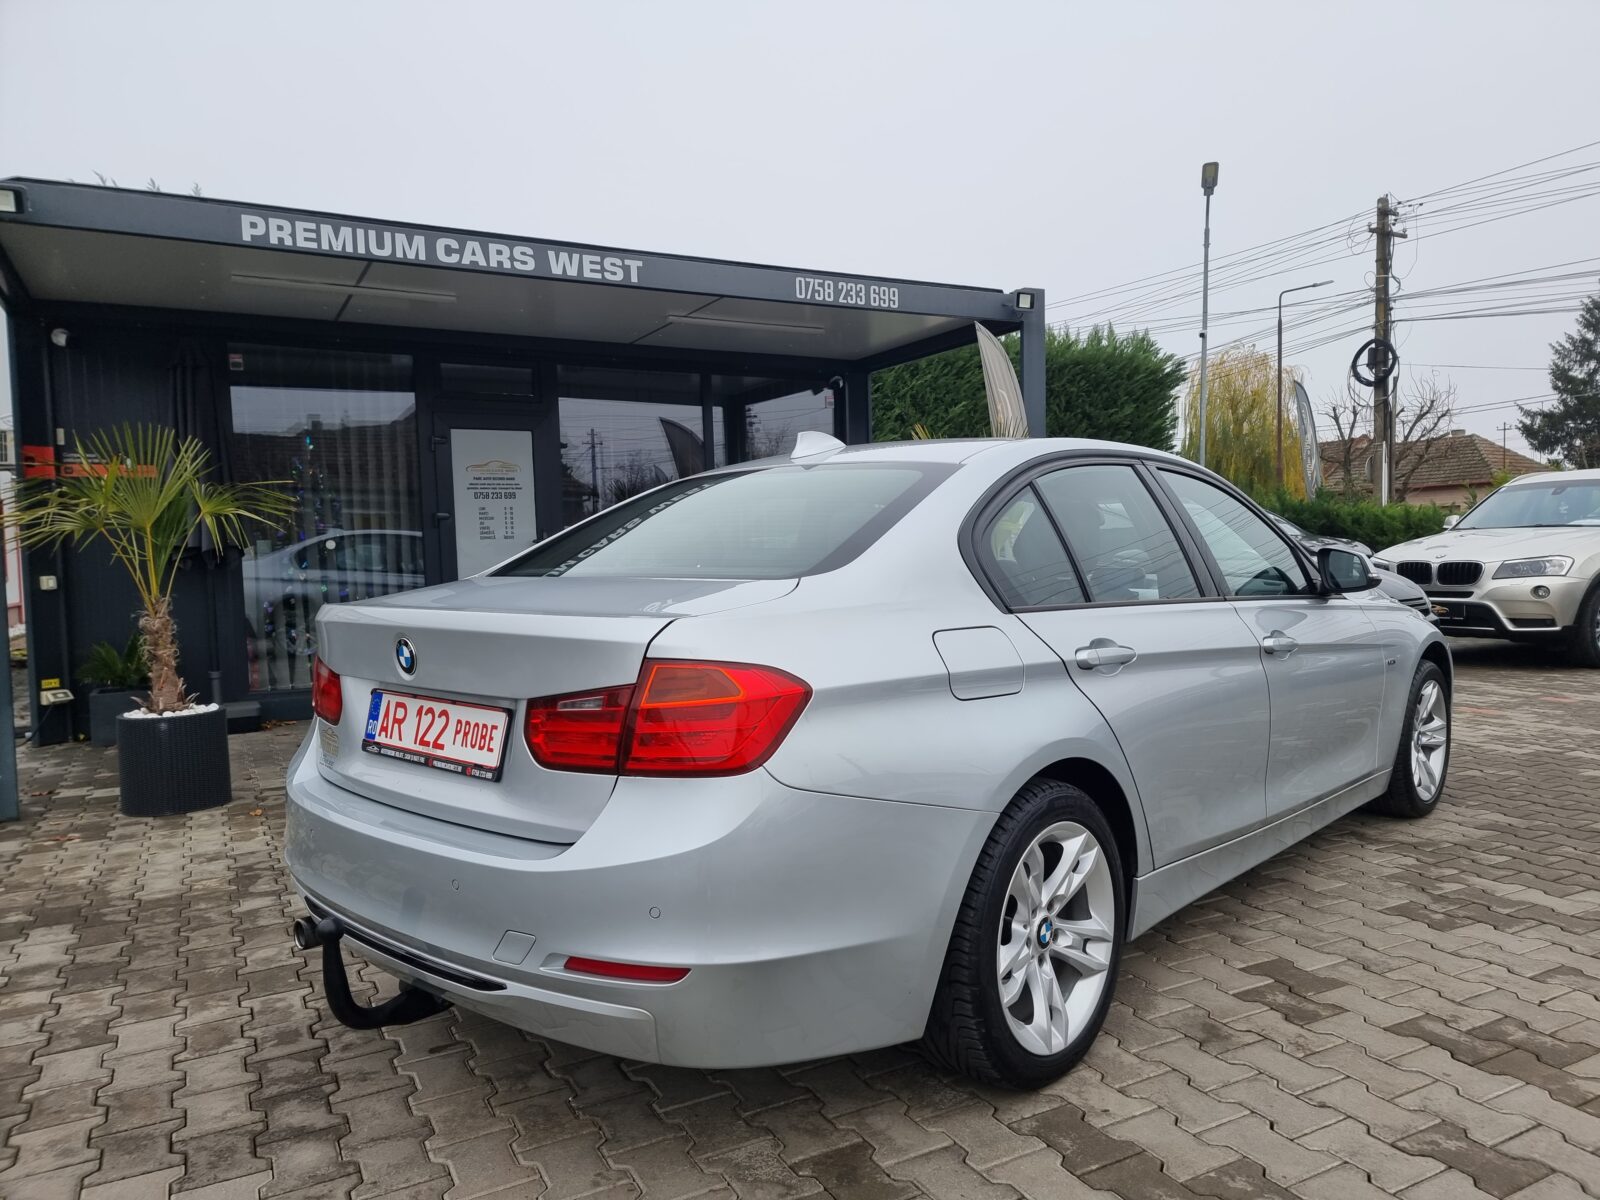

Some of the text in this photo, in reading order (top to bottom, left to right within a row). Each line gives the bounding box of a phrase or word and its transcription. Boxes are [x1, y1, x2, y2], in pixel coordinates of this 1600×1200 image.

[241, 214, 643, 283] PREMIUM CARS WEST
[795, 276, 899, 309] 0758 233 699
[473, 491, 517, 500] 0758 233 699
[367, 719, 377, 734] RO
[378, 700, 498, 753] AR 122 PROBE
